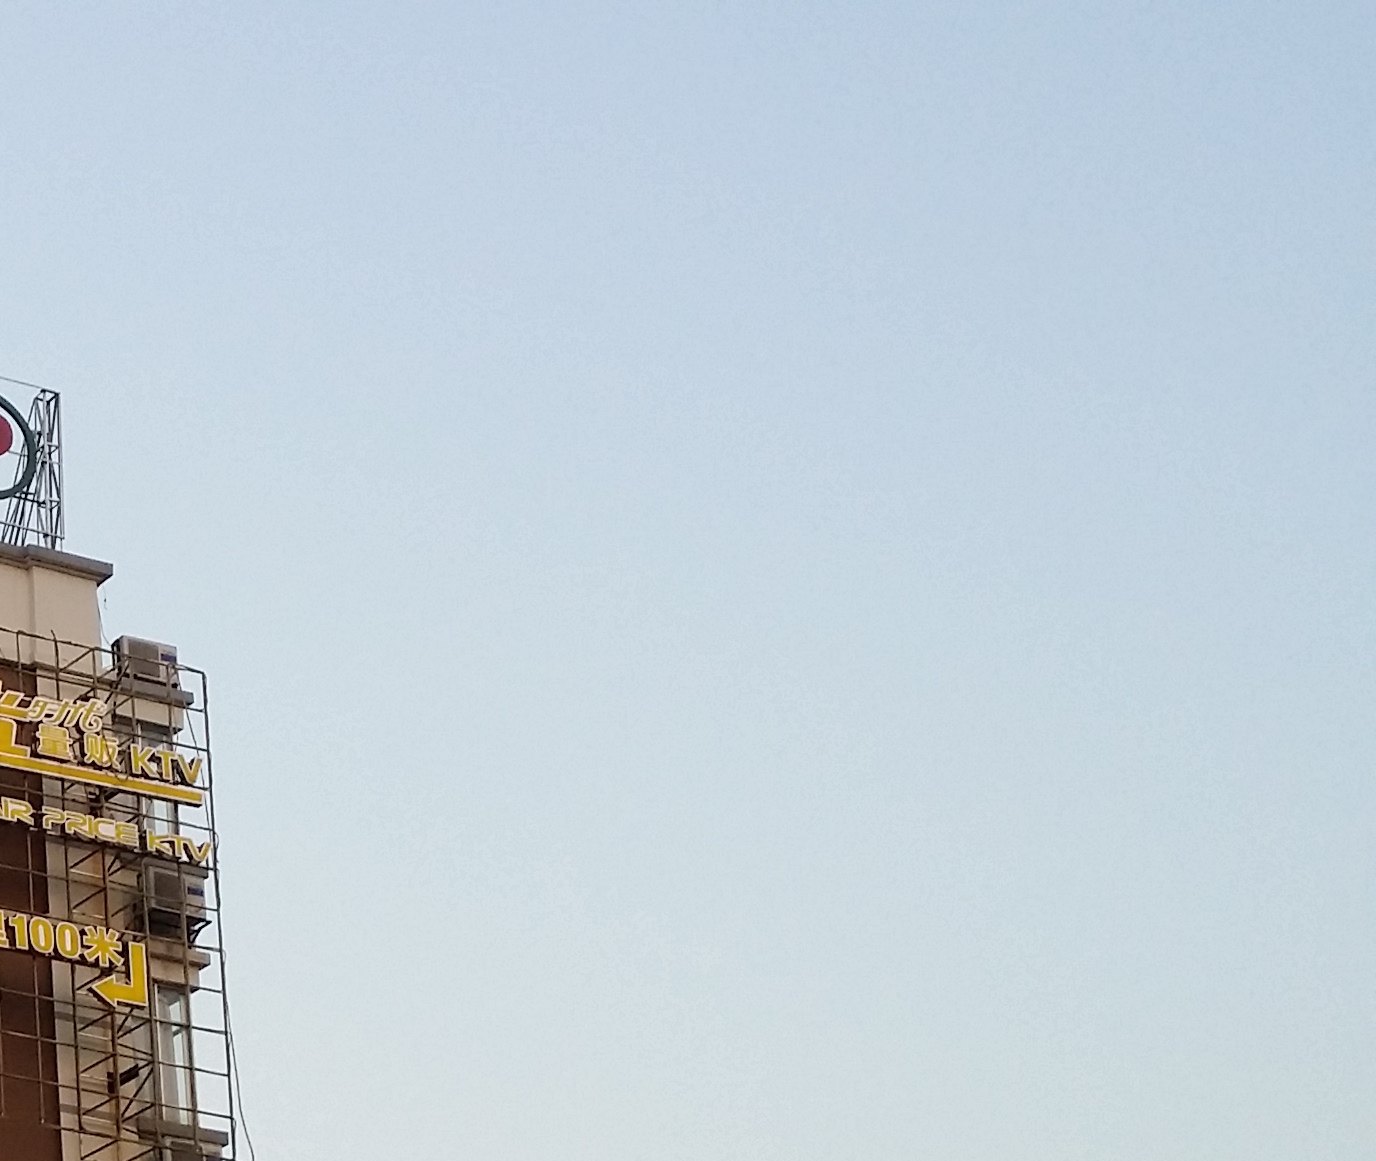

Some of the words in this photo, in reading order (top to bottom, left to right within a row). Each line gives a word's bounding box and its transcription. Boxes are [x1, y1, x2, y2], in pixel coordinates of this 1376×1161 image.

[129, 743, 203, 786] KTV
[42, 805, 140, 848] PRICE
[146, 829, 212, 866] KTV
